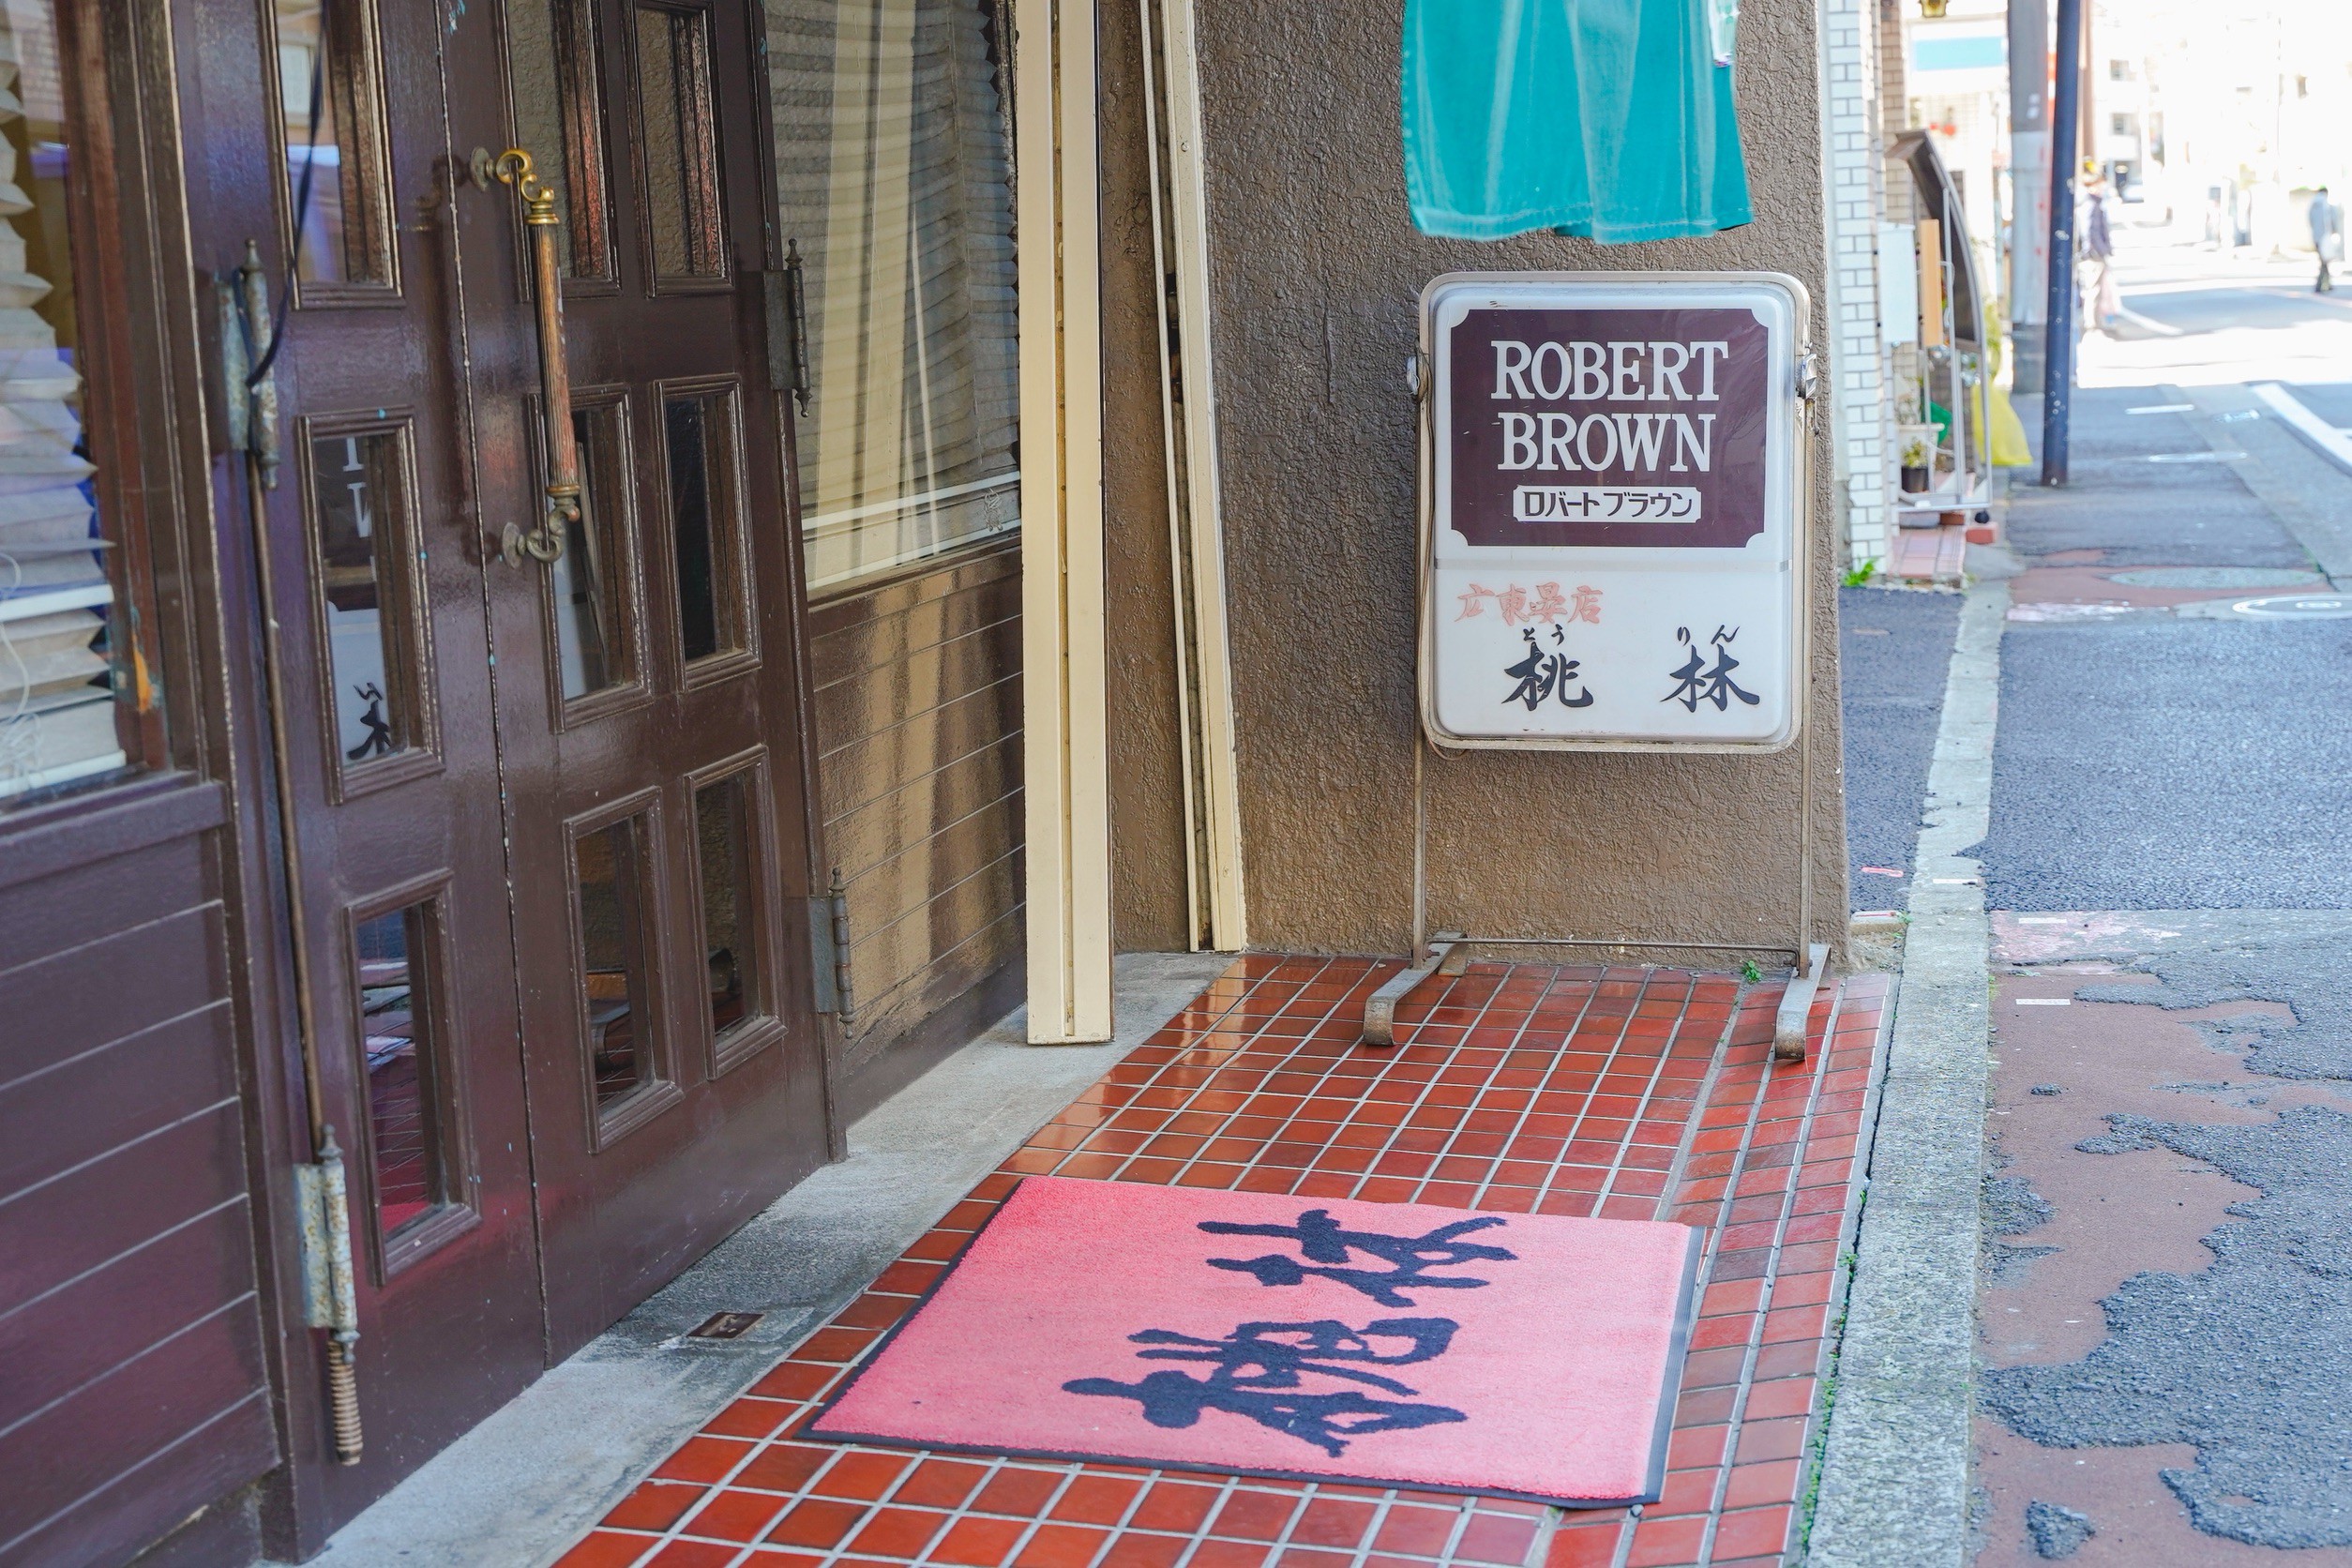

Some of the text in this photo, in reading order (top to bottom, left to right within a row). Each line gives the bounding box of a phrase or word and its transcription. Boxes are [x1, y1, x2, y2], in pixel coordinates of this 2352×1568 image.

[1491, 341, 1728, 400] ROBERT
[1498, 413, 1715, 472] BROWN
[1523, 491, 1694, 518] ロバートブラウン
[1677, 625, 1740, 646] りん
